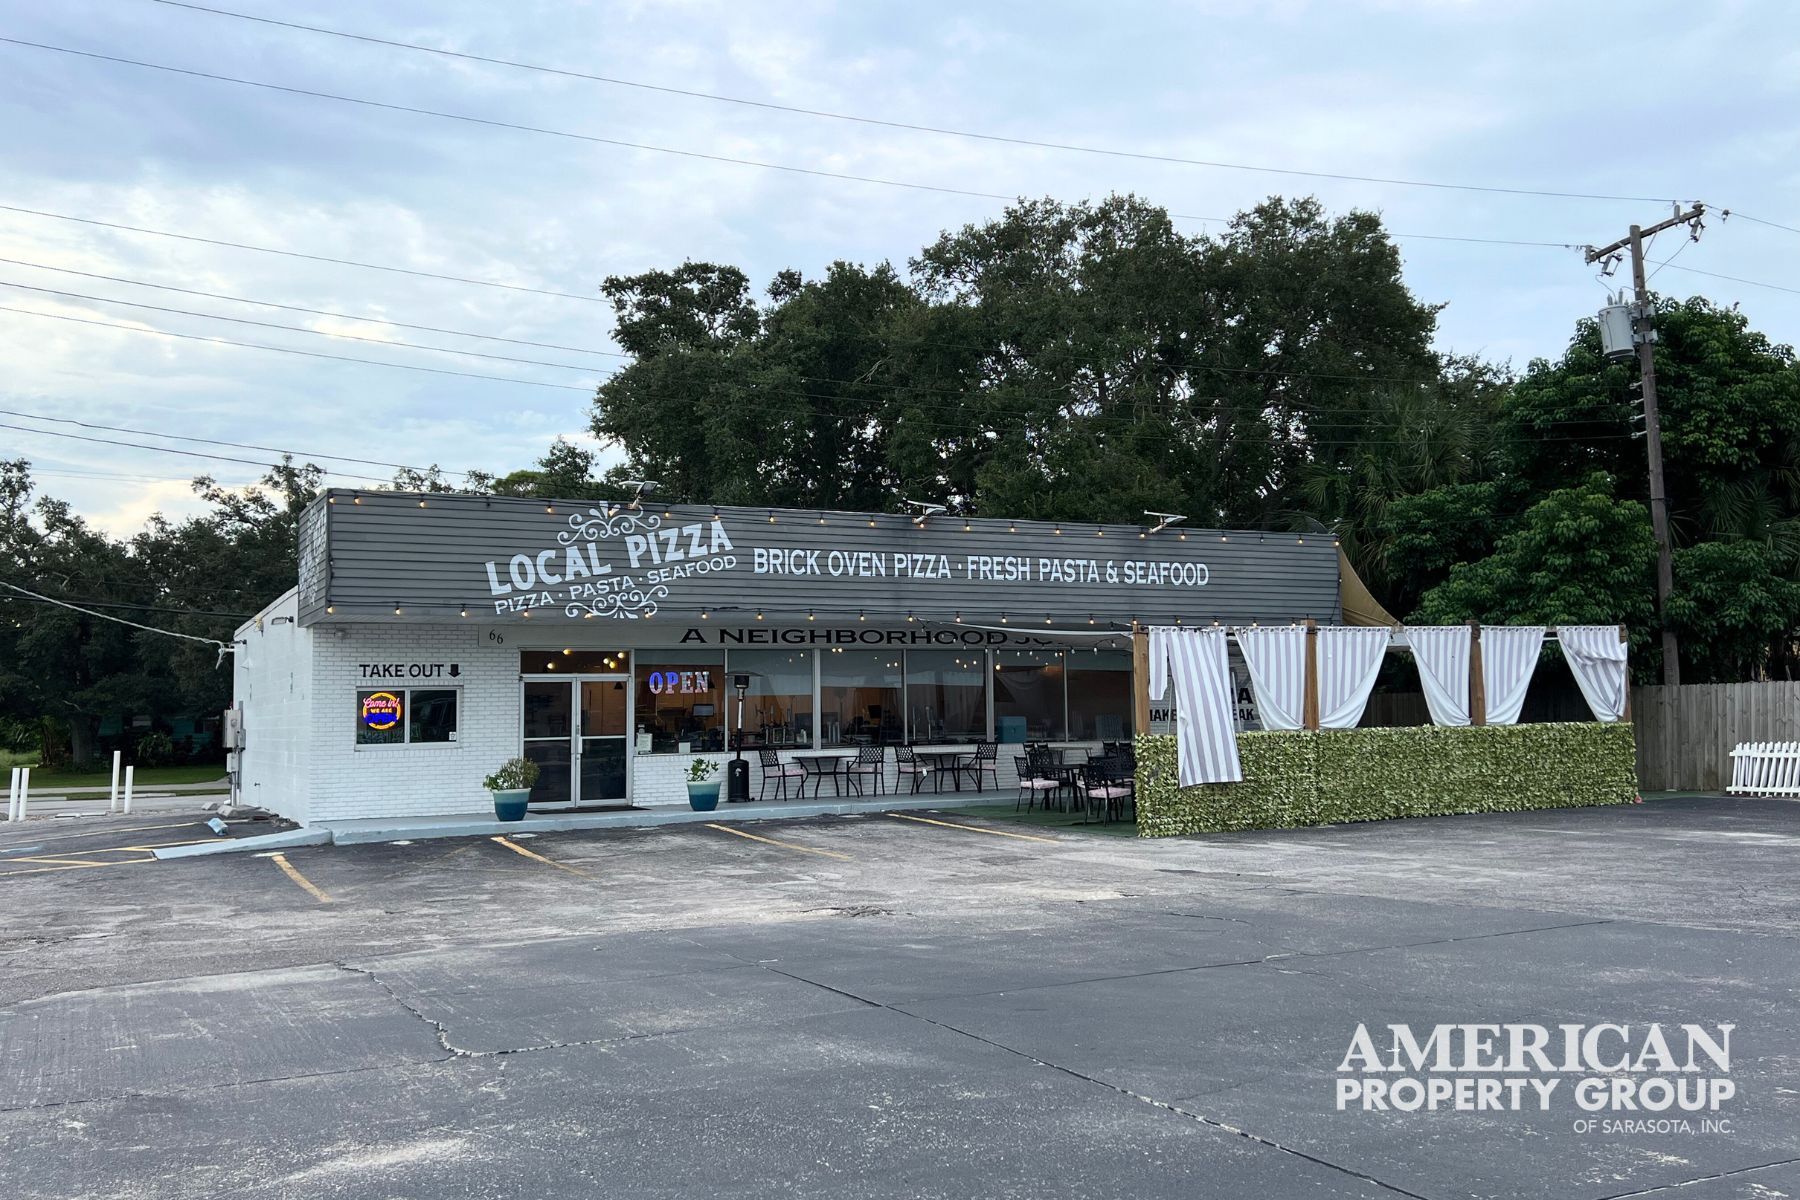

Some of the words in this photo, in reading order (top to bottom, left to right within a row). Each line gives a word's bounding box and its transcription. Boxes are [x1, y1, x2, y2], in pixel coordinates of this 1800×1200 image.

[485, 543, 612, 596] LOCAL
[624, 520, 734, 568] PIZZA
[753, 548, 822, 575] BRICK
[828, 551, 886, 577] OVEN
[893, 553, 952, 578] PIZZA
[967, 556, 1030, 580] FRESH
[1038, 558, 1100, 583] PASTA
[1105, 560, 1119, 584] &
[1123, 560, 1209, 586] SEAFOOD
[494, 591, 555, 615] PIZZA
[569, 576, 635, 600] PASTA
[647, 555, 737, 585] SEAFOOD
[680, 628, 707, 644] A
[719, 628, 1007, 645] NEIGHBORHOOD
[359, 664, 405, 677] TAKE
[408, 664, 444, 677] OUT
[649, 671, 710, 695] OPEN
